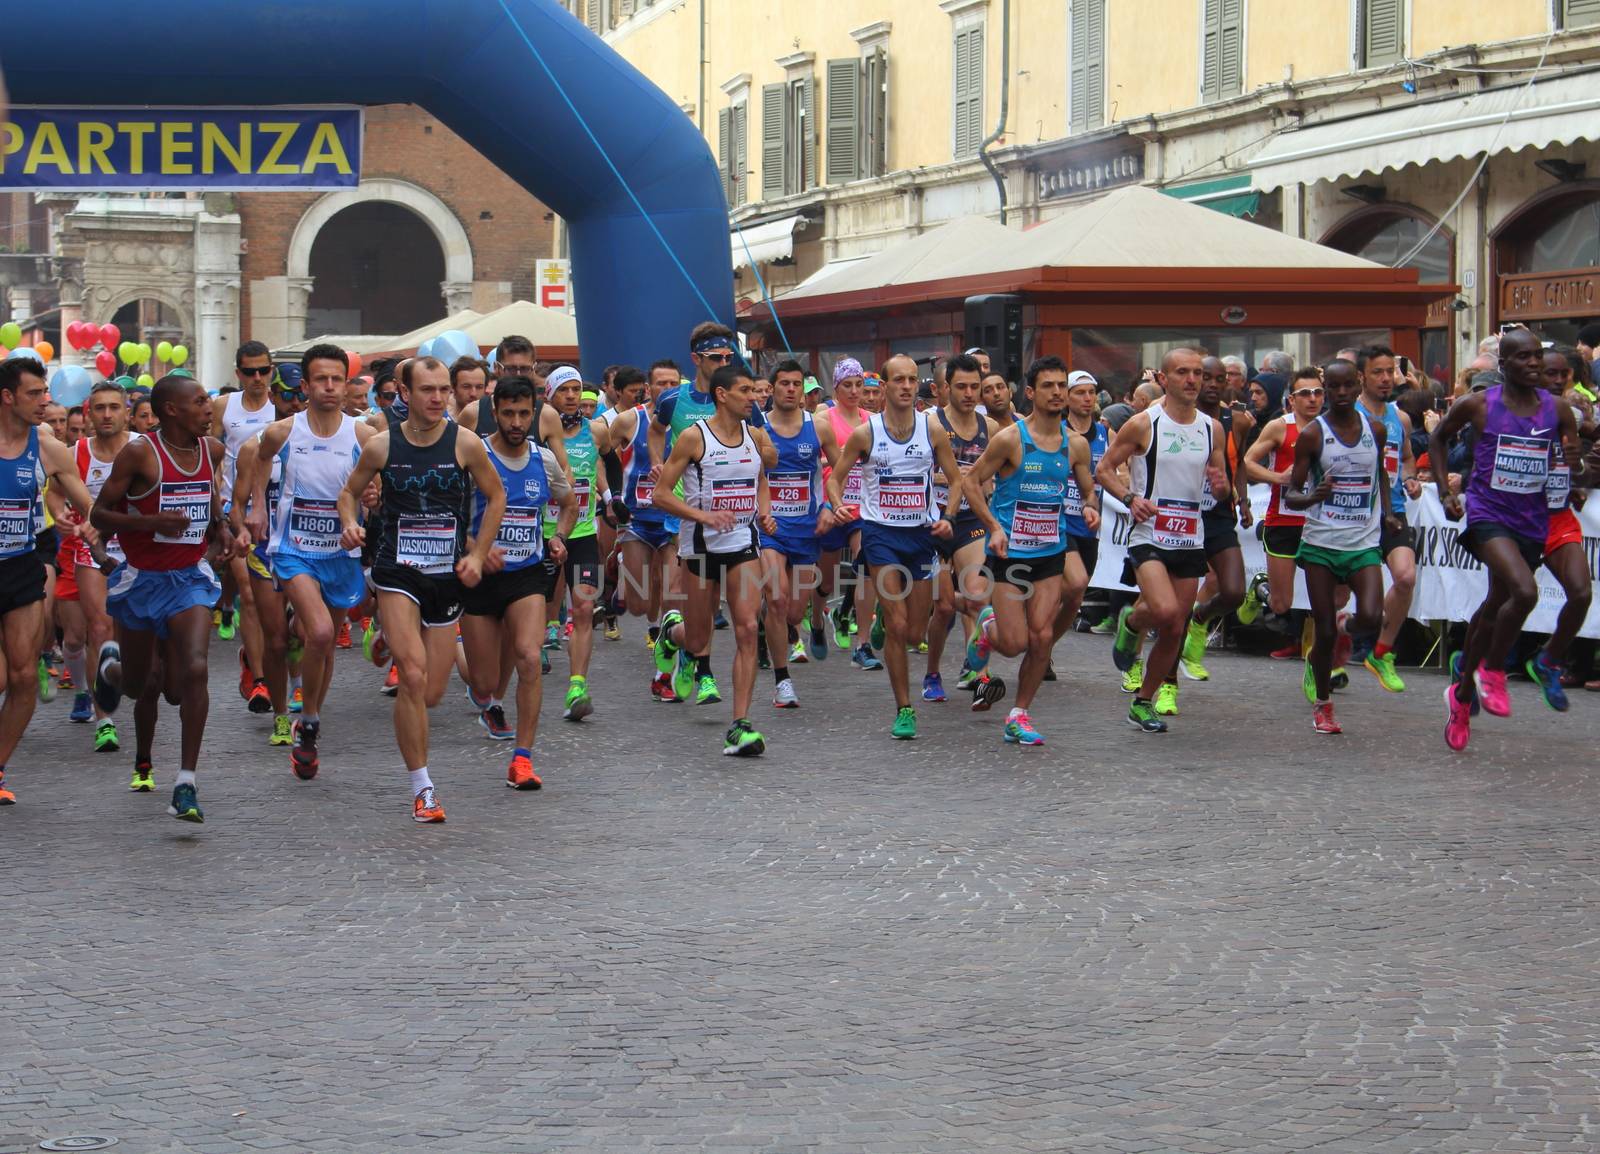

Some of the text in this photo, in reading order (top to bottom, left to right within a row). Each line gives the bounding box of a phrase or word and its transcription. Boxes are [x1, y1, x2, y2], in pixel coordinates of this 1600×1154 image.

[0, 121, 353, 174] PARTENZA
[1513, 280, 1594, 309] BAR CENTRO
[1498, 456, 1544, 473] MANG'ATA
[778, 488, 800, 500] 426
[880, 494, 921, 505] ARAGNO
[1333, 493, 1361, 506] RONO
[712, 498, 753, 509] LISITANO
[883, 512, 921, 520] Vassalli
[1327, 512, 1367, 520] Vassalli
[298, 516, 335, 533] H860
[1014, 519, 1056, 534] DE FRANCESCO
[1166, 518, 1187, 532] 472
[500, 527, 531, 541] 1065
[294, 536, 338, 548] Vassalli
[1157, 536, 1195, 546] Vassalli
